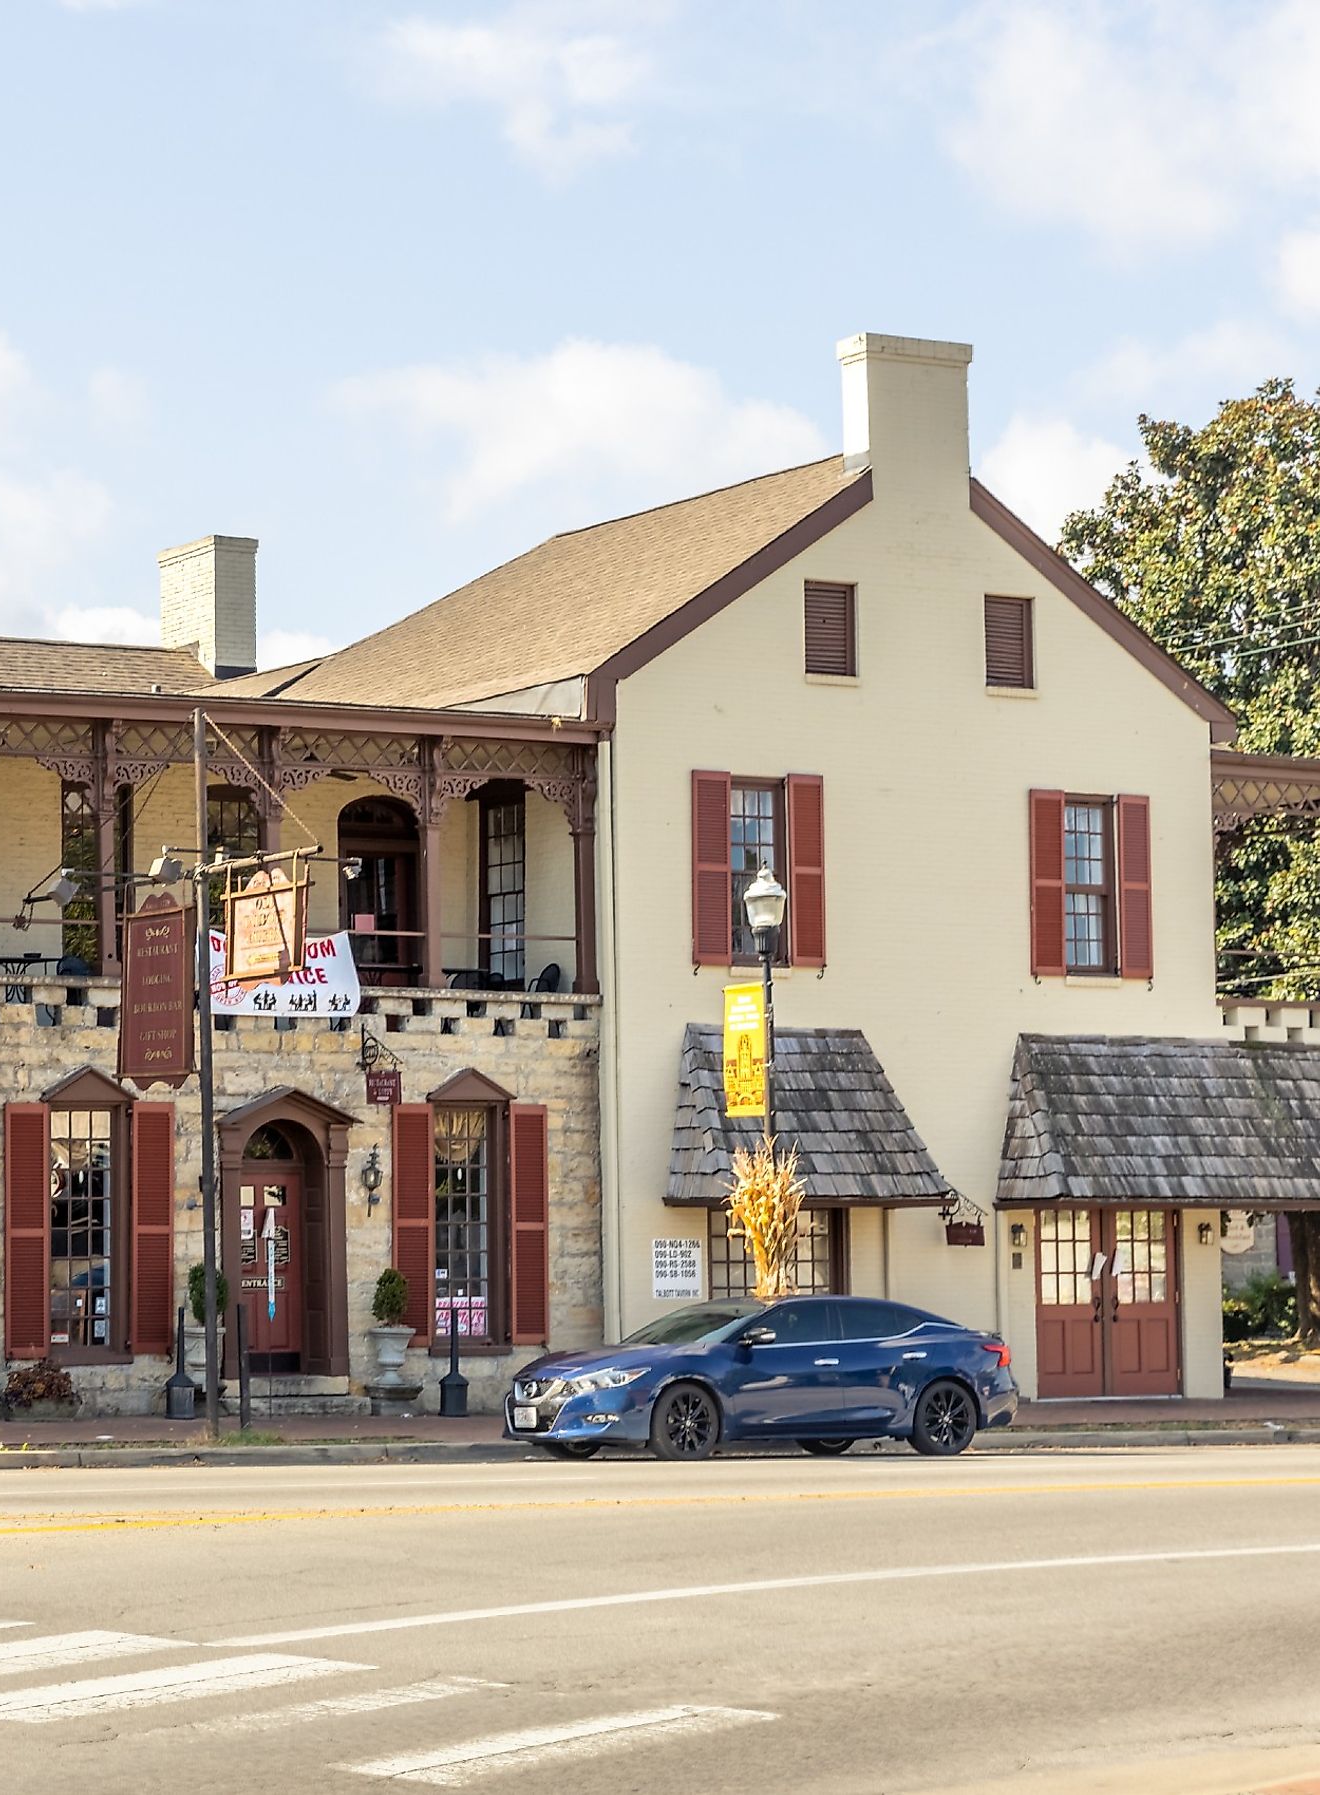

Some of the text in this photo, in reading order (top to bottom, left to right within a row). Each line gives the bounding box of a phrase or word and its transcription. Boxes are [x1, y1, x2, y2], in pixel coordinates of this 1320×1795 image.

[136, 943, 179, 957] RESTAURANT
[142, 973, 173, 986] LODGING
[133, 1000, 183, 1015] BOURBON BAR
[241, 1278, 282, 1288] ENTRACE
